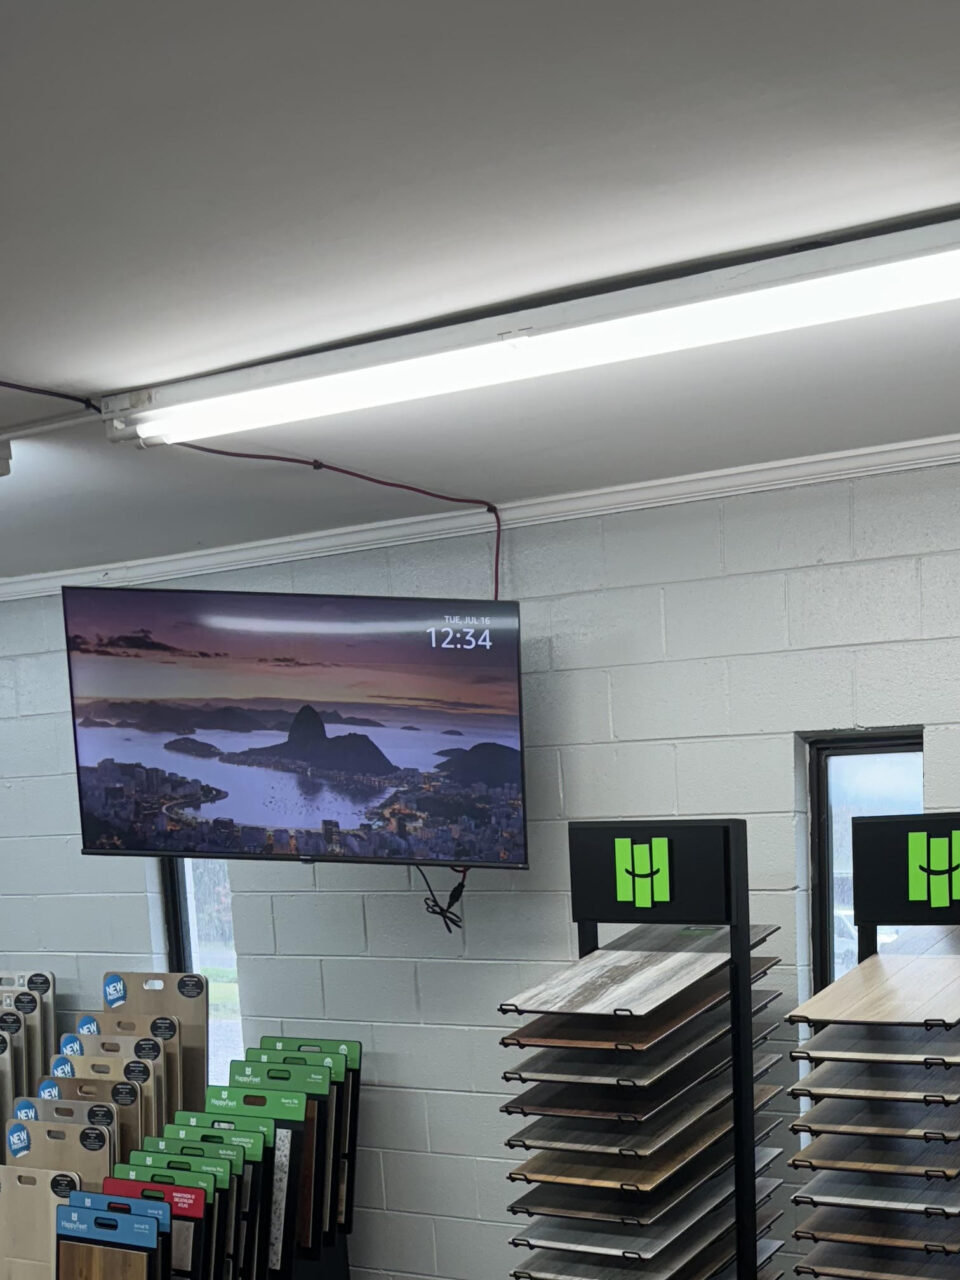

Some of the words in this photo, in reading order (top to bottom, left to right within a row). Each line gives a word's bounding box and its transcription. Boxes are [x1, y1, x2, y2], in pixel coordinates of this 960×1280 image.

[464, 617, 479, 625] JUL
[480, 617, 491, 625] 16
[426, 627, 492, 650] 12:34
[105, 979, 123, 995] NEW
[79, 1021, 97, 1035] NEW
[62, 1041, 79, 1055] NEW
[53, 1062, 71, 1077] NEW
[40, 1086, 59, 1100] NEW
[17, 1108, 35, 1120] NEW
[9, 1130, 27, 1145] NEW
[61, 1220, 88, 1231] HappyFeet
